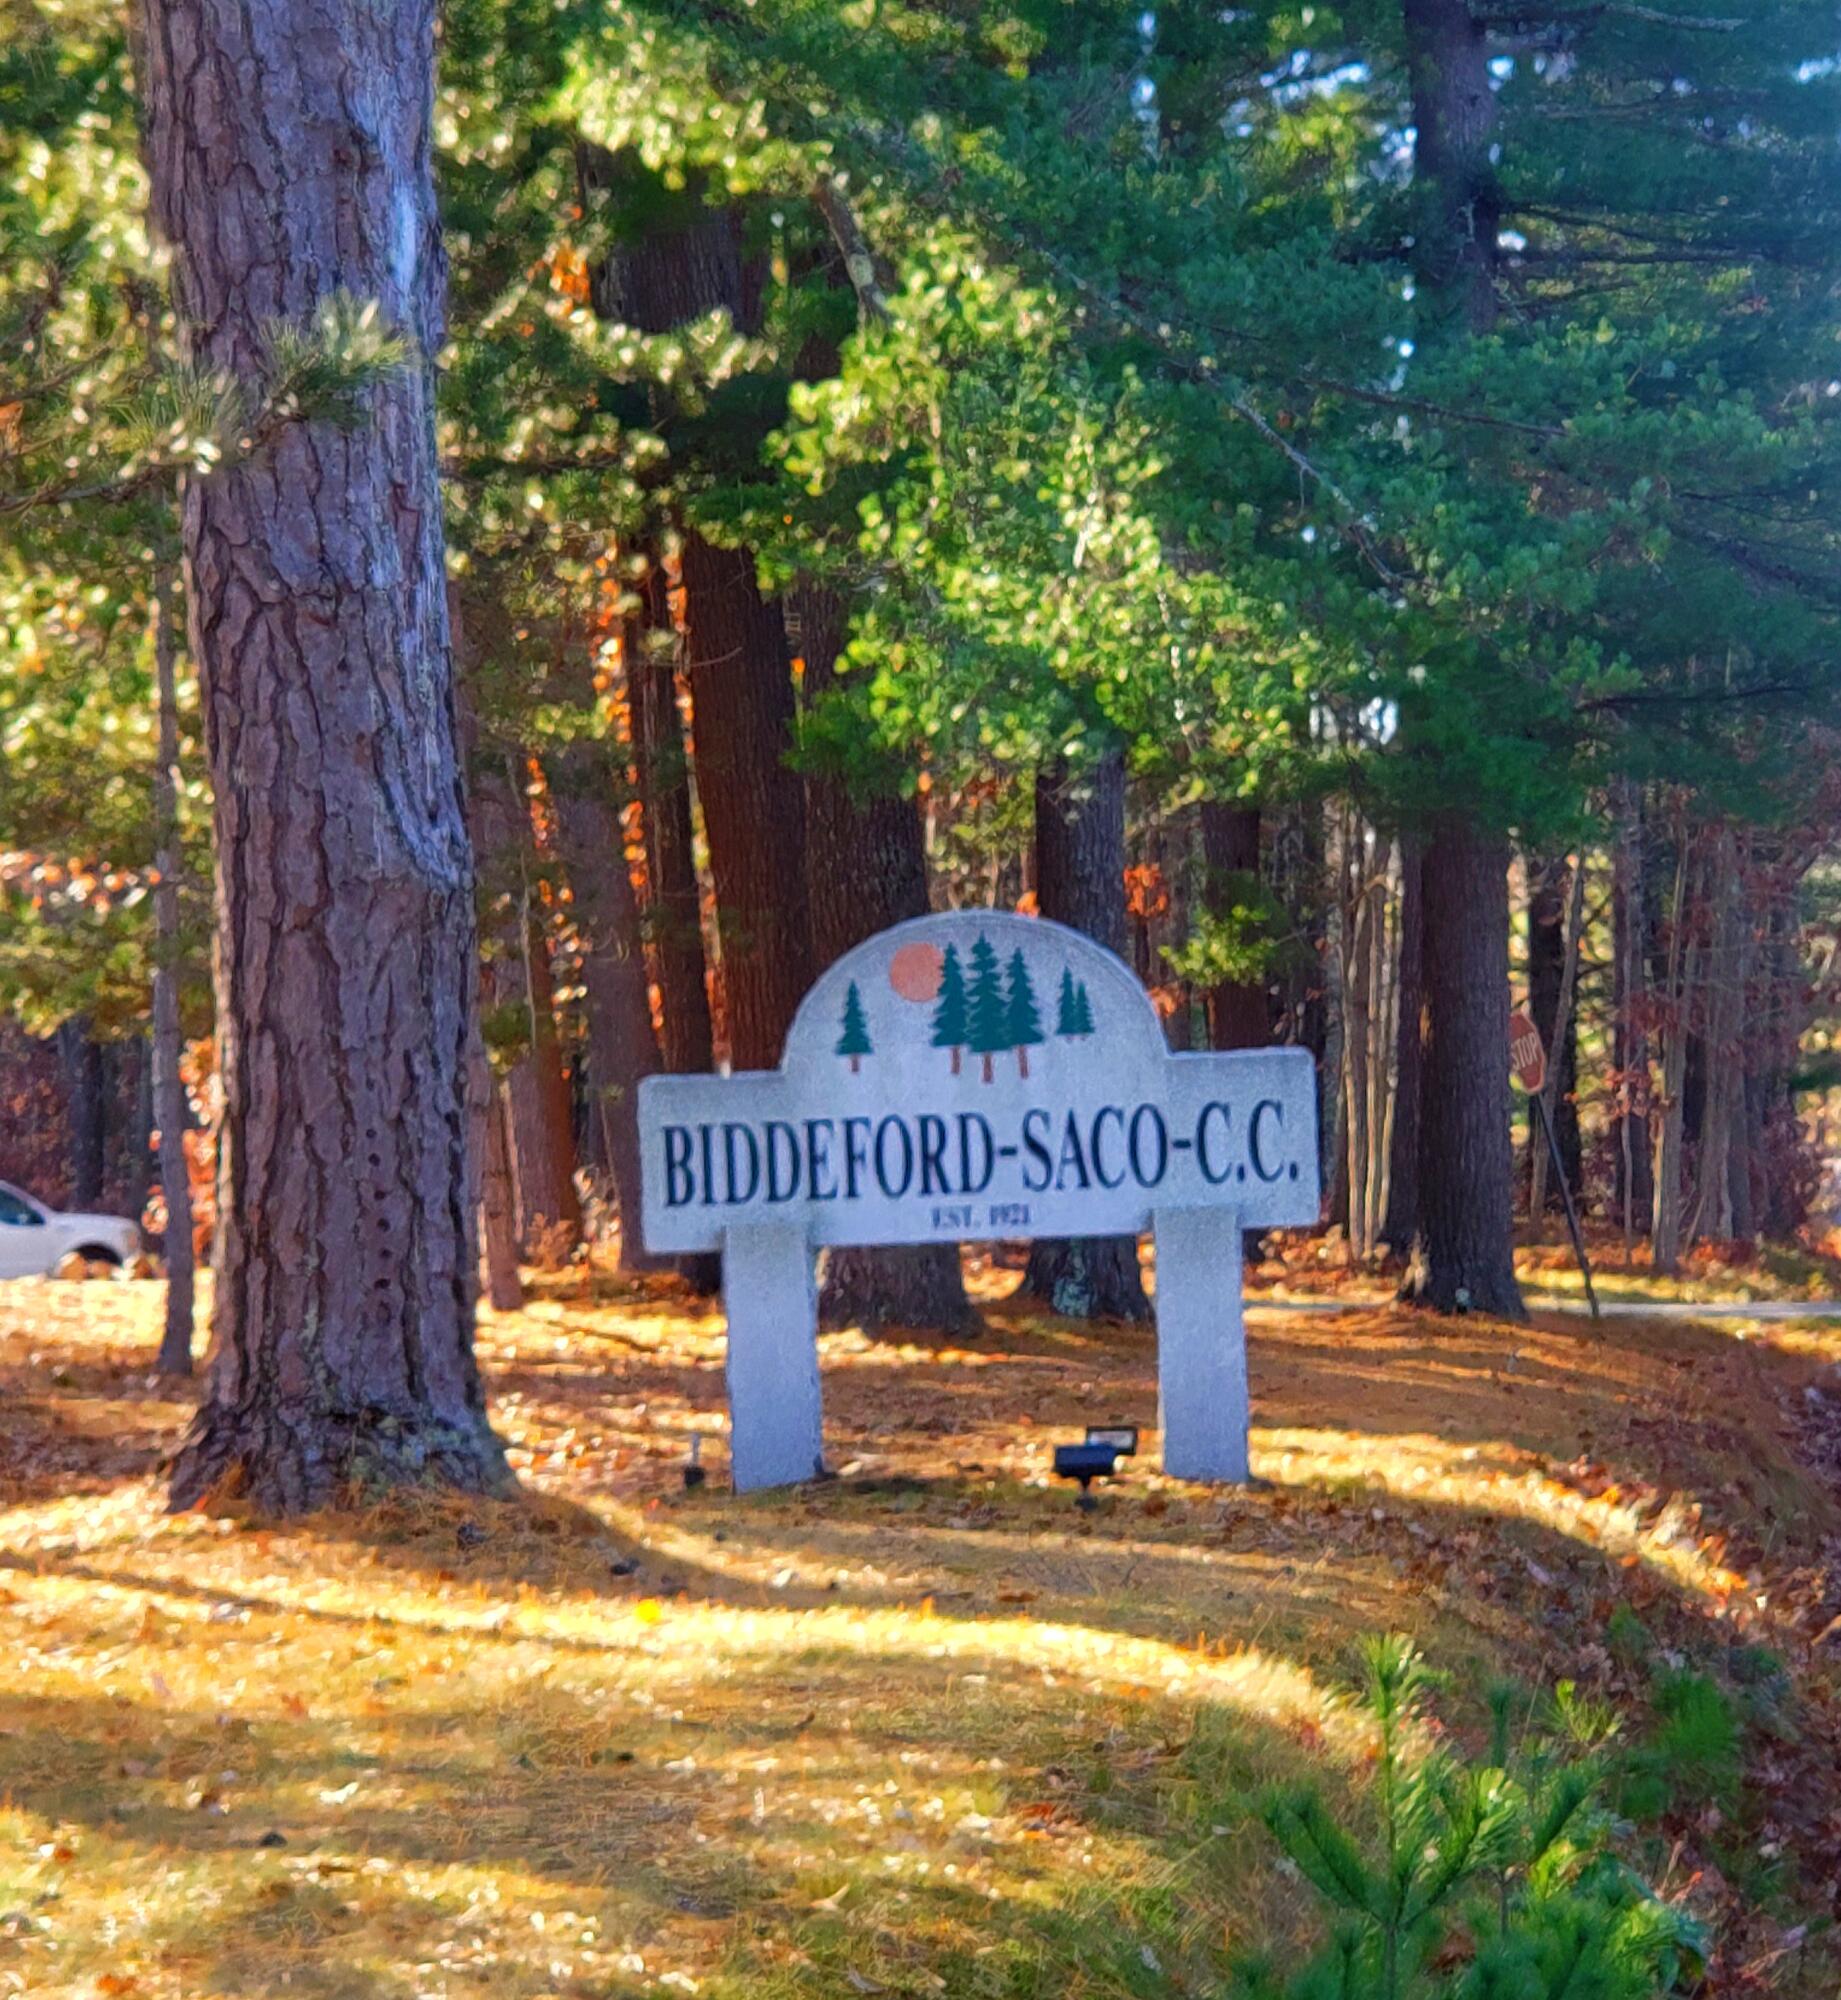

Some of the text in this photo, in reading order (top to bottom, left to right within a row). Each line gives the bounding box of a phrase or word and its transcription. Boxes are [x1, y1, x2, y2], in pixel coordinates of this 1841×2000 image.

[1511, 1032, 1538, 1072] STOP
[663, 1099, 1299, 1208] BIDDEFORD-SACO-C.C.
[931, 1207, 980, 1229] EST.
